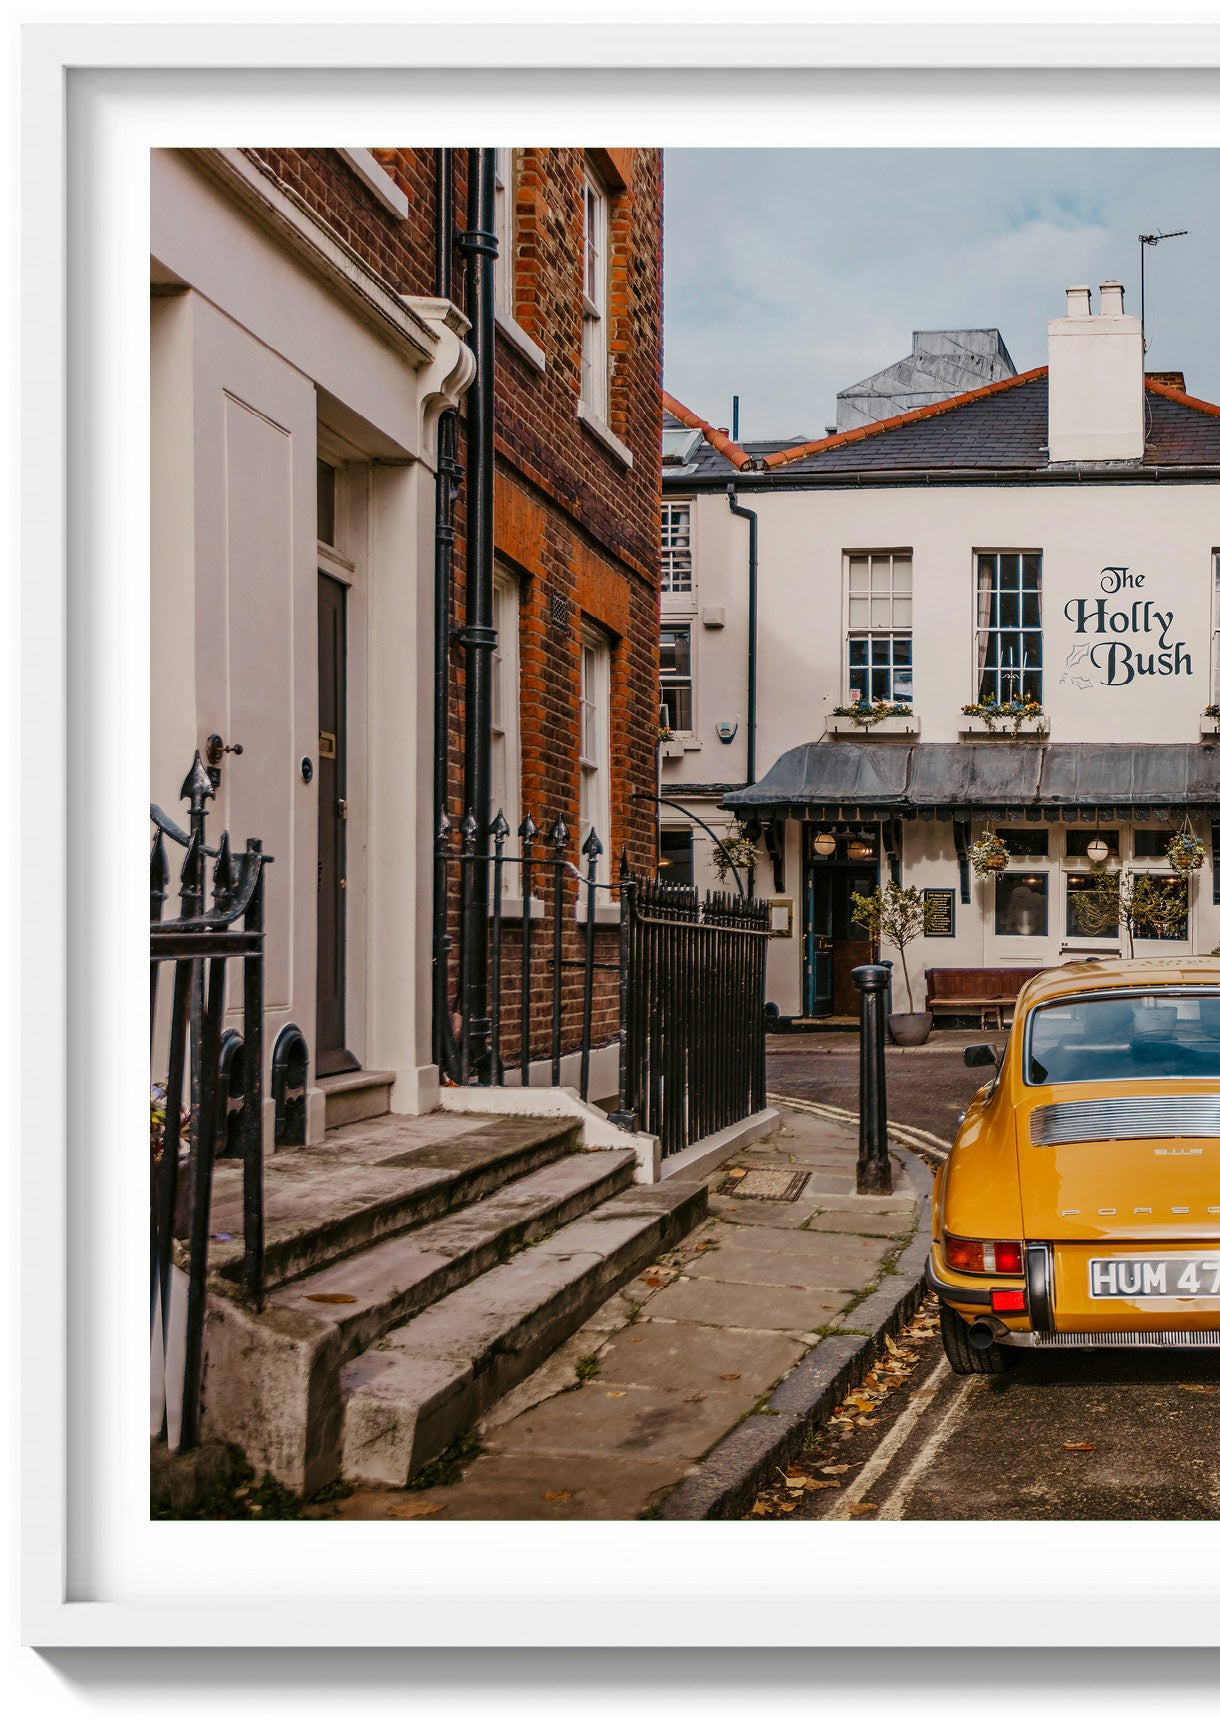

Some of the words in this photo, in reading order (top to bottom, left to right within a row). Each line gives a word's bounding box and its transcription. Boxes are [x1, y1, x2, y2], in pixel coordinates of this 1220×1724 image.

[1100, 567, 1146, 594] The
[1064, 598, 1174, 650] Holly
[1090, 641, 1193, 686] Bush
[1093, 1262, 1167, 1294] HUM
